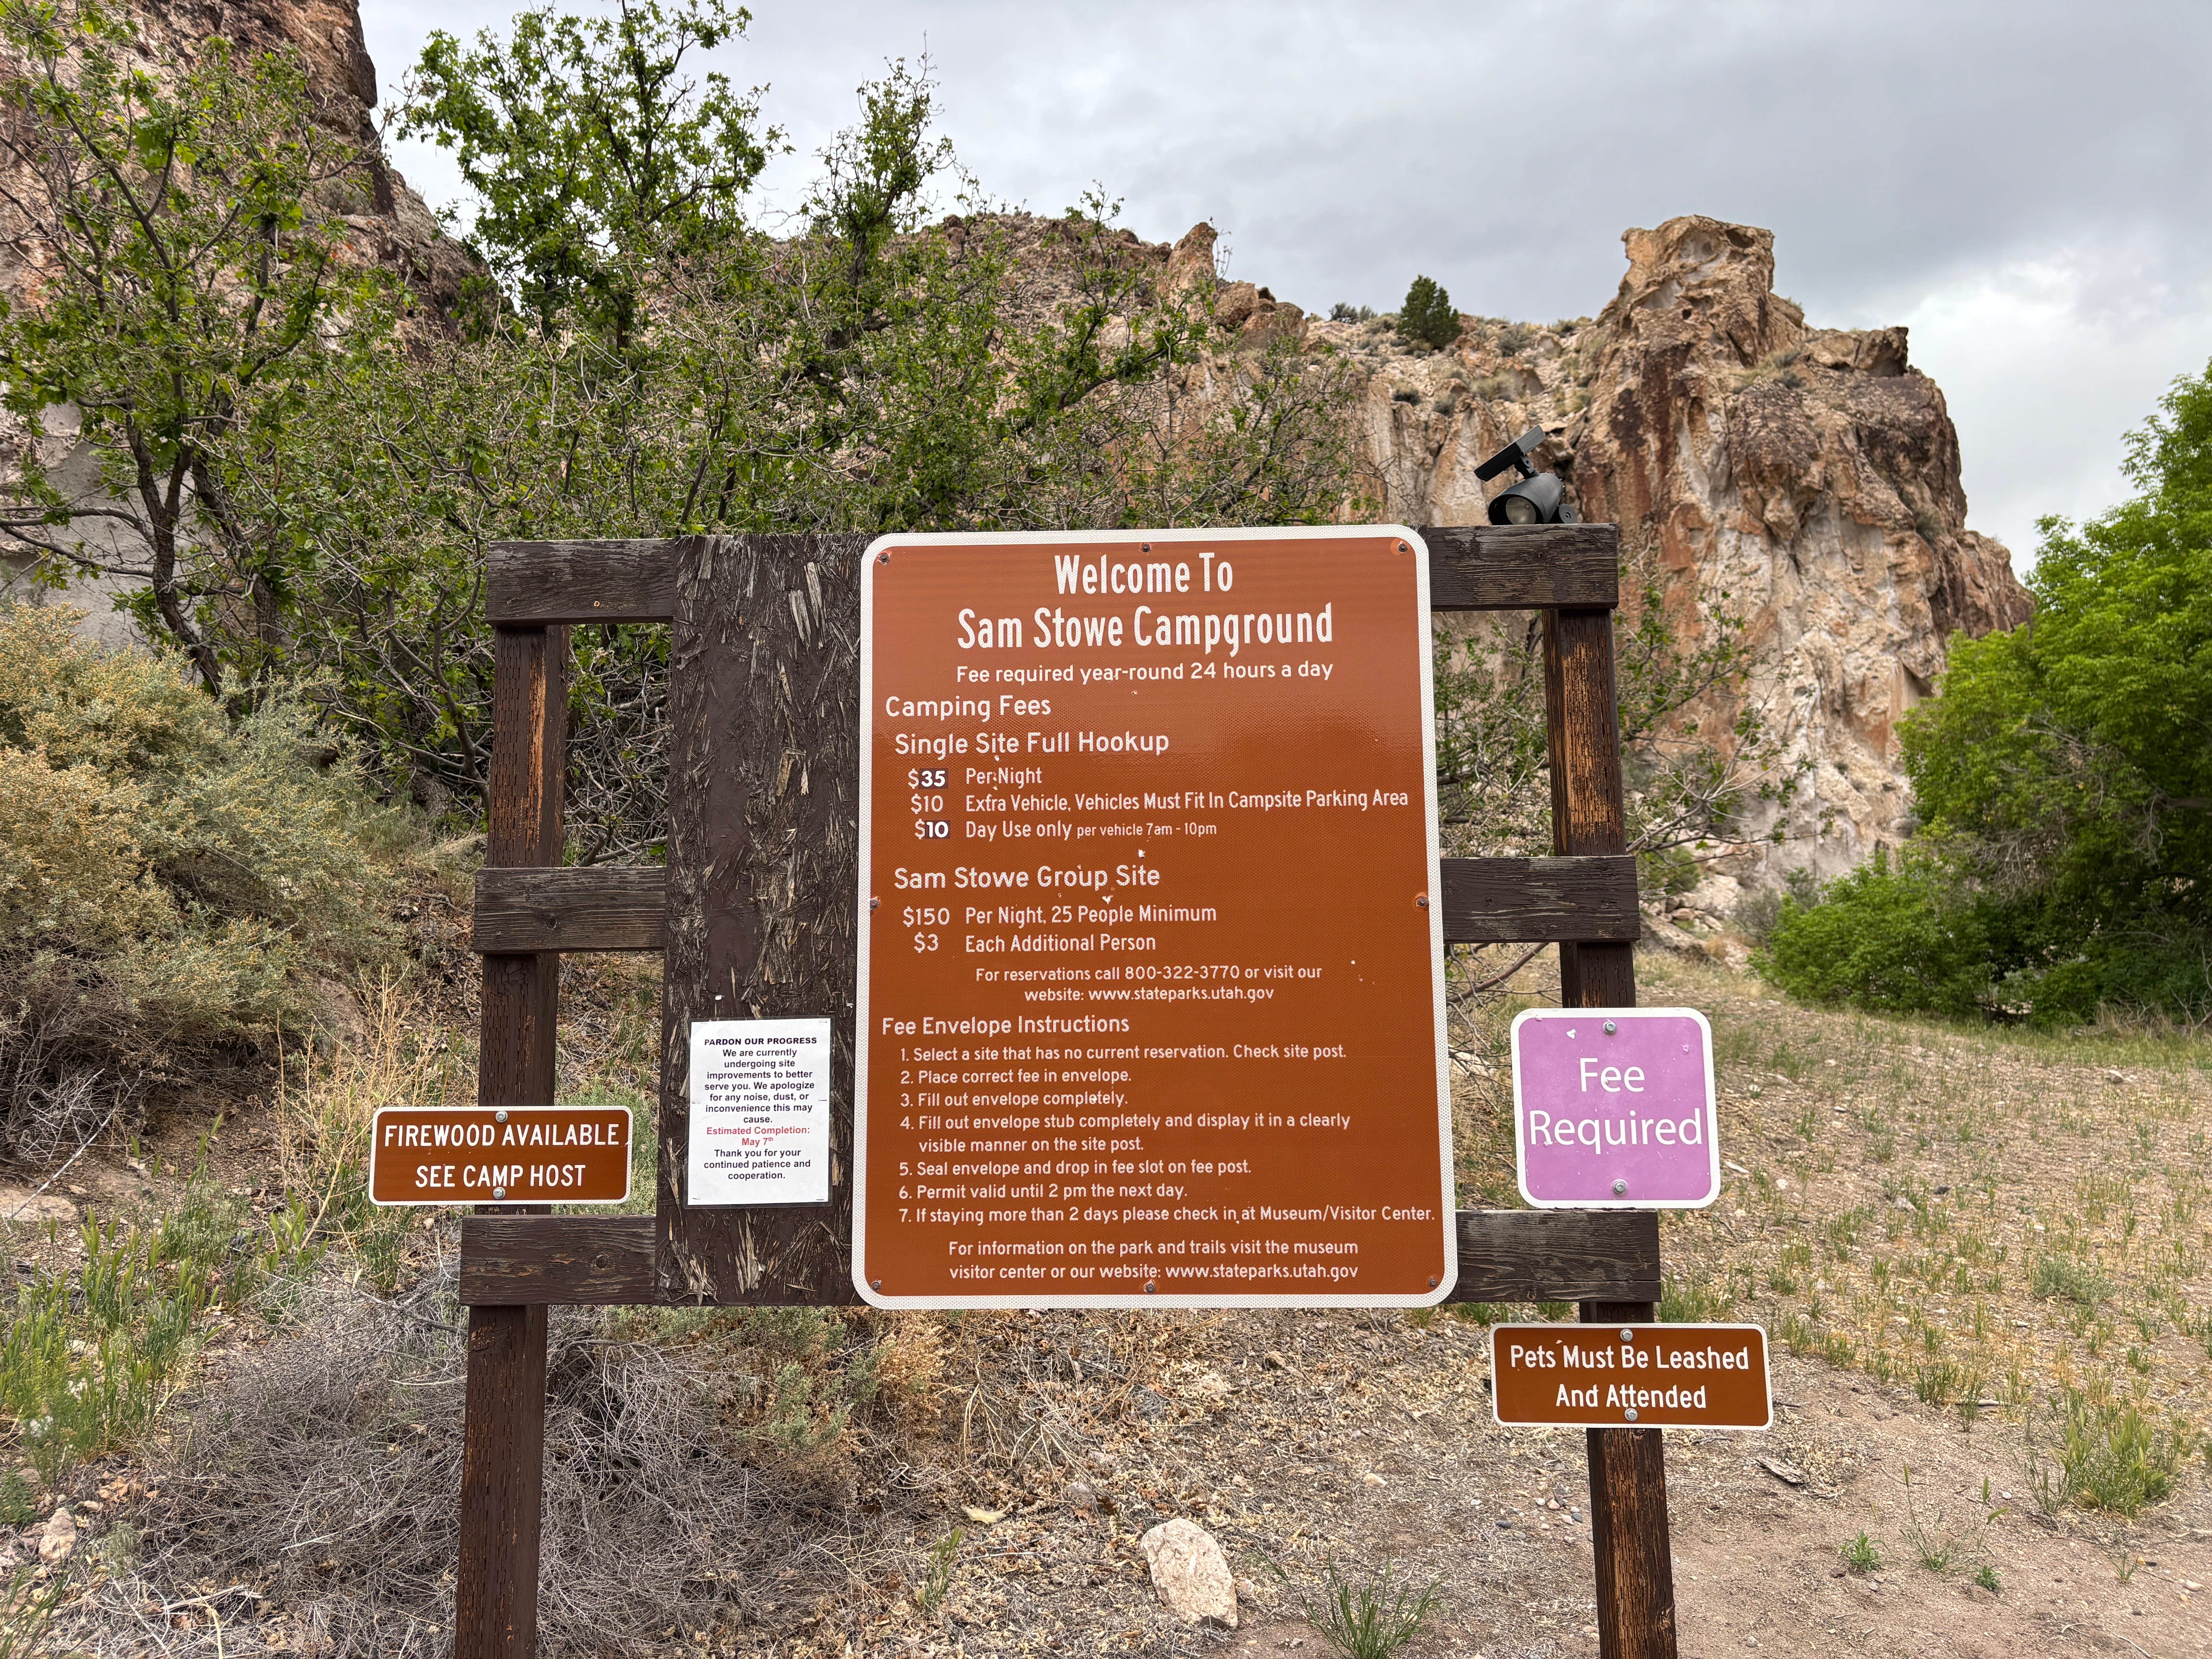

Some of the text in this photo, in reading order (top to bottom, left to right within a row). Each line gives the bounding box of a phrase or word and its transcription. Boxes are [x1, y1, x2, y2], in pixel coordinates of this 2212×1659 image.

[1055, 553, 1232, 594] Welcome To
[958, 603, 1332, 657] Sam Stowe Campground
[957, 661, 1333, 685] Fee required year-round 24 hours a day
[886, 695, 1051, 722] Camping Fees
[895, 731, 1169, 760] Single Site Full Hookup
[908, 767, 1042, 789] $35 Per Night
[911, 789, 1408, 814] $10 Extra Vehicle, Vehicles Must Fit In Campsite Parking Area
[915, 819, 948, 840] $10
[966, 821, 997, 842] Day
[1003, 821, 1031, 837] Use
[1037, 820, 1072, 840] only
[1077, 827, 1096, 838] per
[1100, 824, 1143, 836] vehicle
[1146, 823, 1172, 835] 7am
[1185, 823, 1216, 837] 10pm
[895, 865, 1160, 891] Sam Stowe Group Site
[903, 905, 1216, 928] $150 Per Night, 25 People Minimum
[914, 932, 1156, 953] $3 Each Additional Person
[977, 965, 1322, 981] For reservations call 800-322-3770 or visit our
[1025, 986, 1274, 1003] website: www.stateparks.utah.gov
[883, 1015, 1129, 1037] Fee Envelope Instructions
[756, 1048, 797, 1058] currently
[725, 1060, 776, 1069] undergoing
[1580, 1058, 1644, 1092] Fee
[707, 1072, 771, 1080] improvements
[770, 1081, 814, 1091] apologize
[901, 1068, 1131, 1084] 2. Place correct fee in envelope.
[744, 1093, 770, 1101] noise,
[385, 1124, 618, 1146] FIREWOOD AVAILABLE
[754, 1126, 809, 1135] Completion:
[1530, 1108, 1702, 1154] Required
[742, 1138, 760, 1147] May
[416, 1164, 586, 1187] SEE CAMP HOST
[728, 1171, 785, 1181] cooperation.
[752, 1160, 790, 1170] patience
[899, 1205, 1434, 1226] 7. If staying more than 2 days please check in at Museum/Visitor Center.
[950, 1240, 1358, 1257] For information on the park and trails visit the museum
[950, 1264, 1358, 1282] visitor center or our website: www.stateparks.utah.gov
[1511, 1345, 1748, 1369] Pets Must Be Leashed
[1556, 1384, 1706, 1408] And Attended
